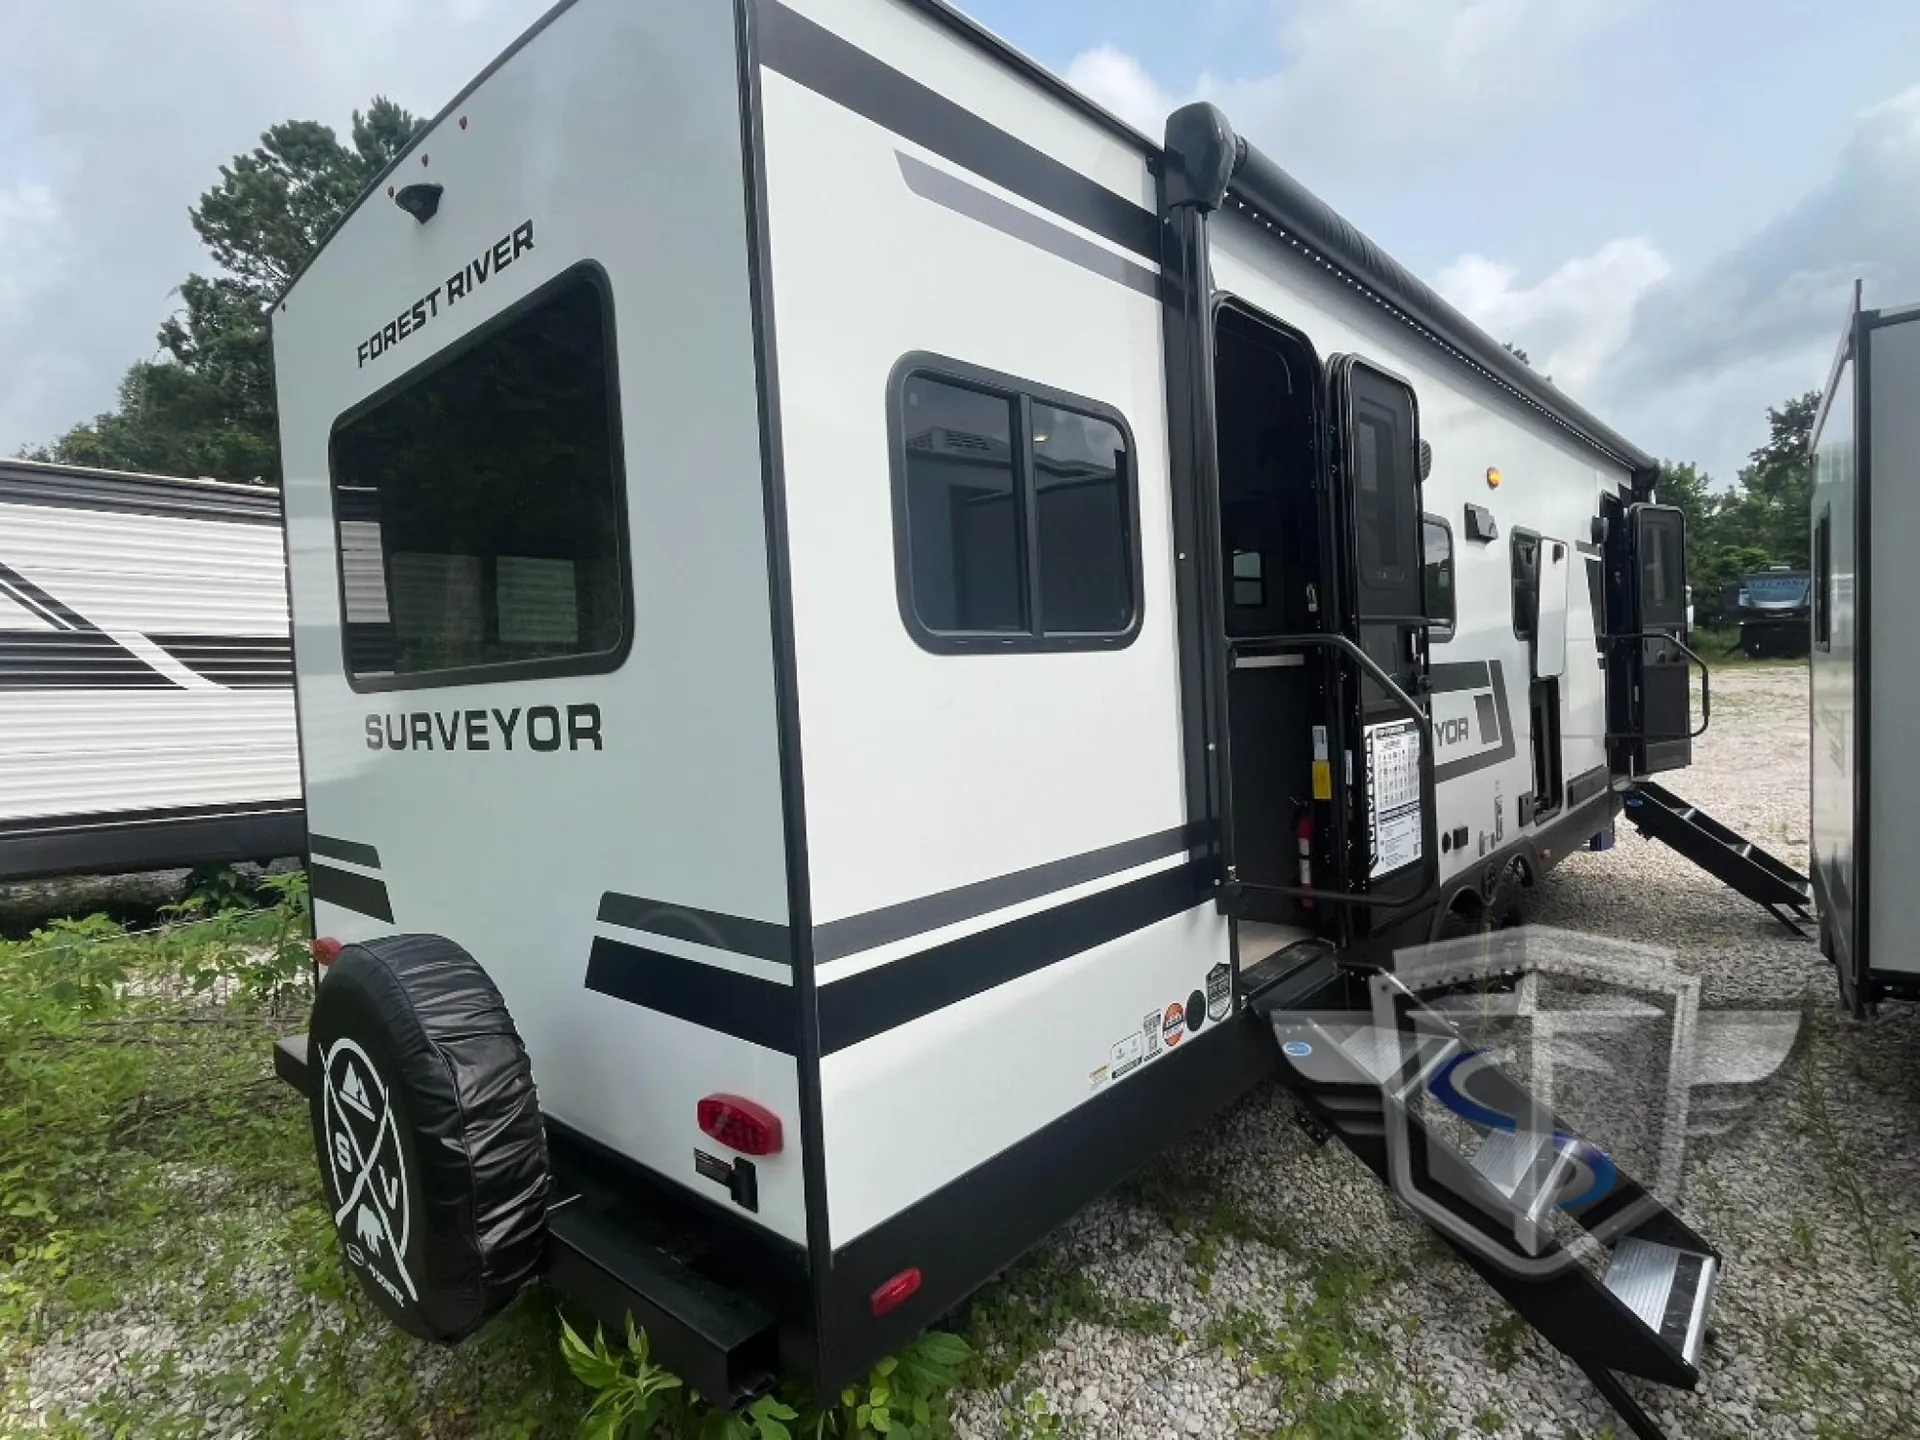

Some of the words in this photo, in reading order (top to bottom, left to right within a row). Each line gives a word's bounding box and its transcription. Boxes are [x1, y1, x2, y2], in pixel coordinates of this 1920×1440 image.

[357, 287, 442, 368] FOREST
[446, 219, 535, 306] RIVER
[365, 703, 603, 752] SURVEYOR
